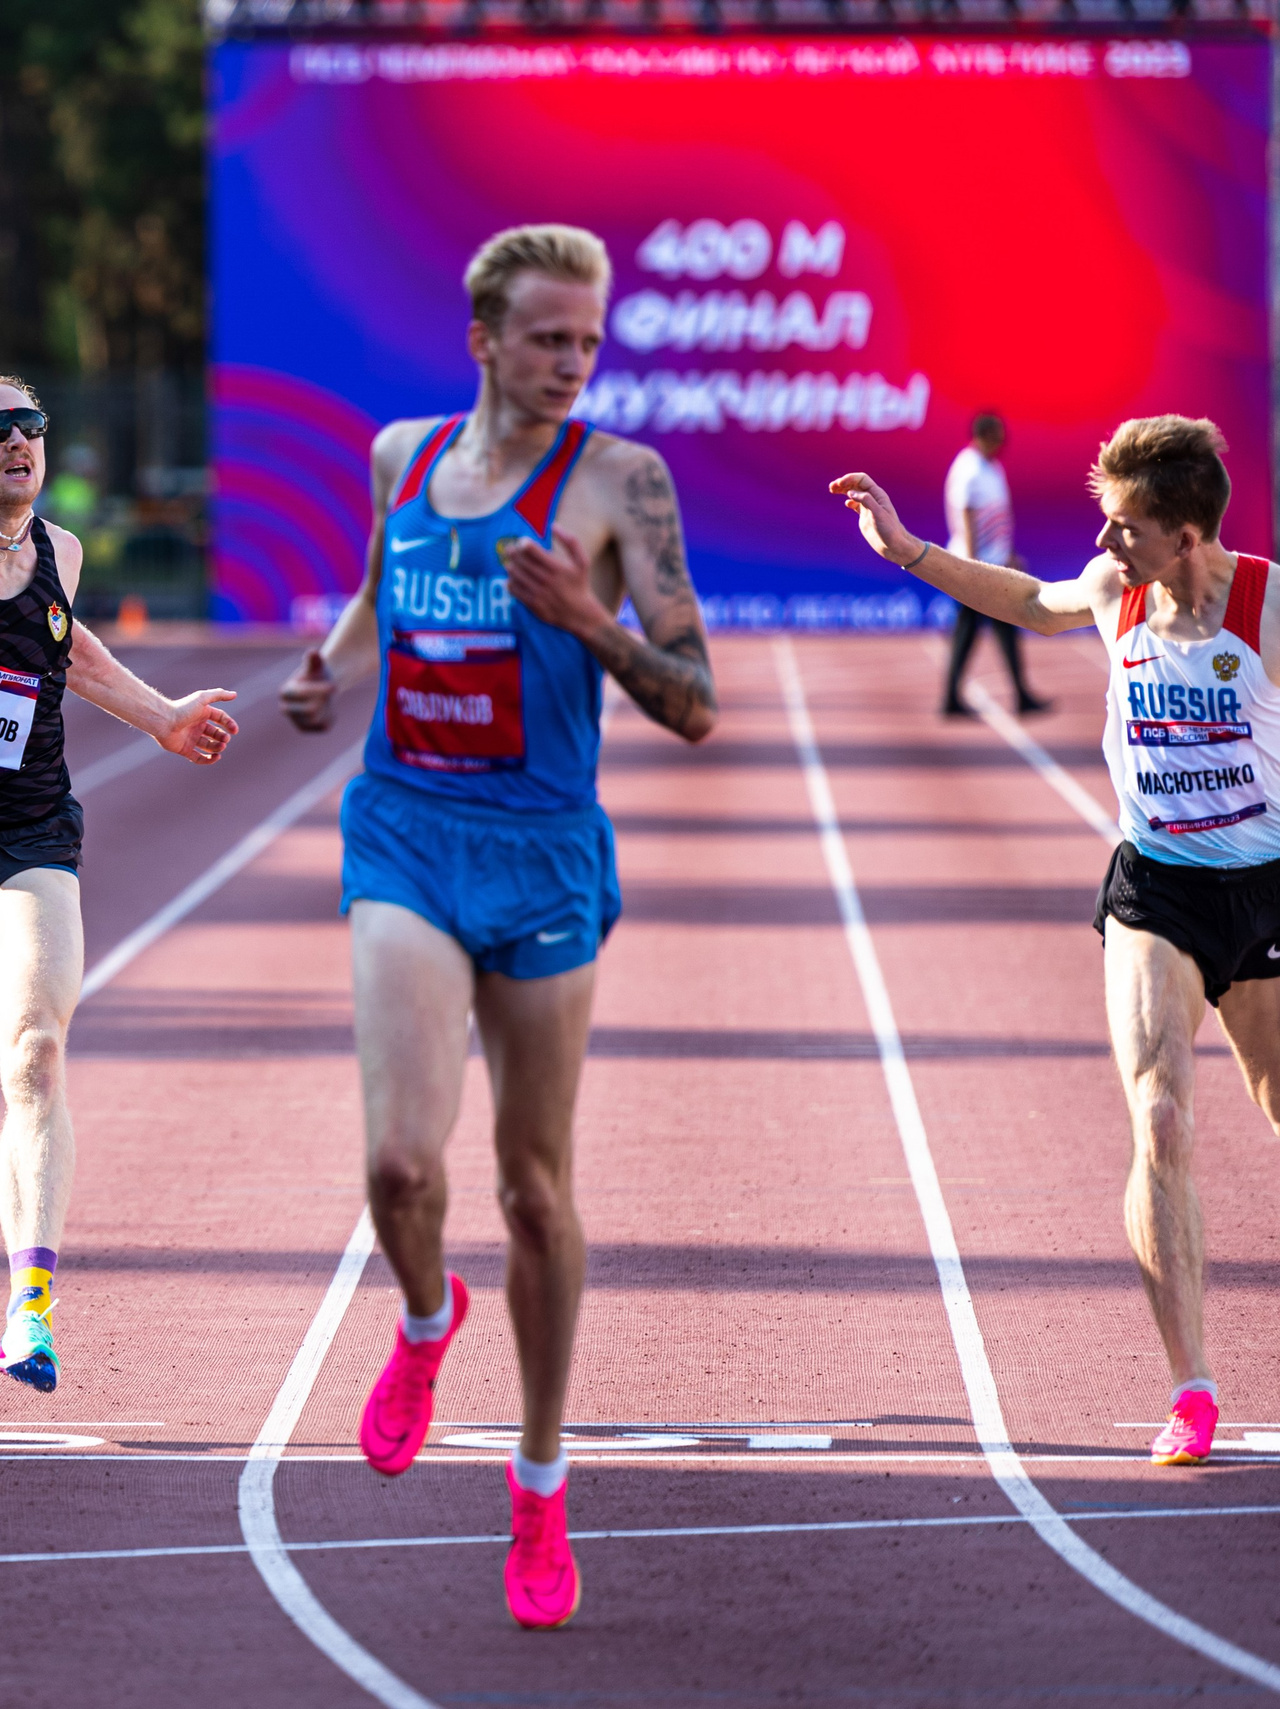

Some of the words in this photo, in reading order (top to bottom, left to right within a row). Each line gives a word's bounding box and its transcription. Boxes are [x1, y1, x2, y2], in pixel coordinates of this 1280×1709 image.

[636, 219, 772, 281] 400
[777, 219, 846, 279] М
[611, 289, 872, 352] ФИНАЛ
[1127, 681, 1241, 722] RUSSIA
[1143, 728, 1166, 738] ПСБ
[1136, 763, 1255, 796] МАСЮТЕНКО
